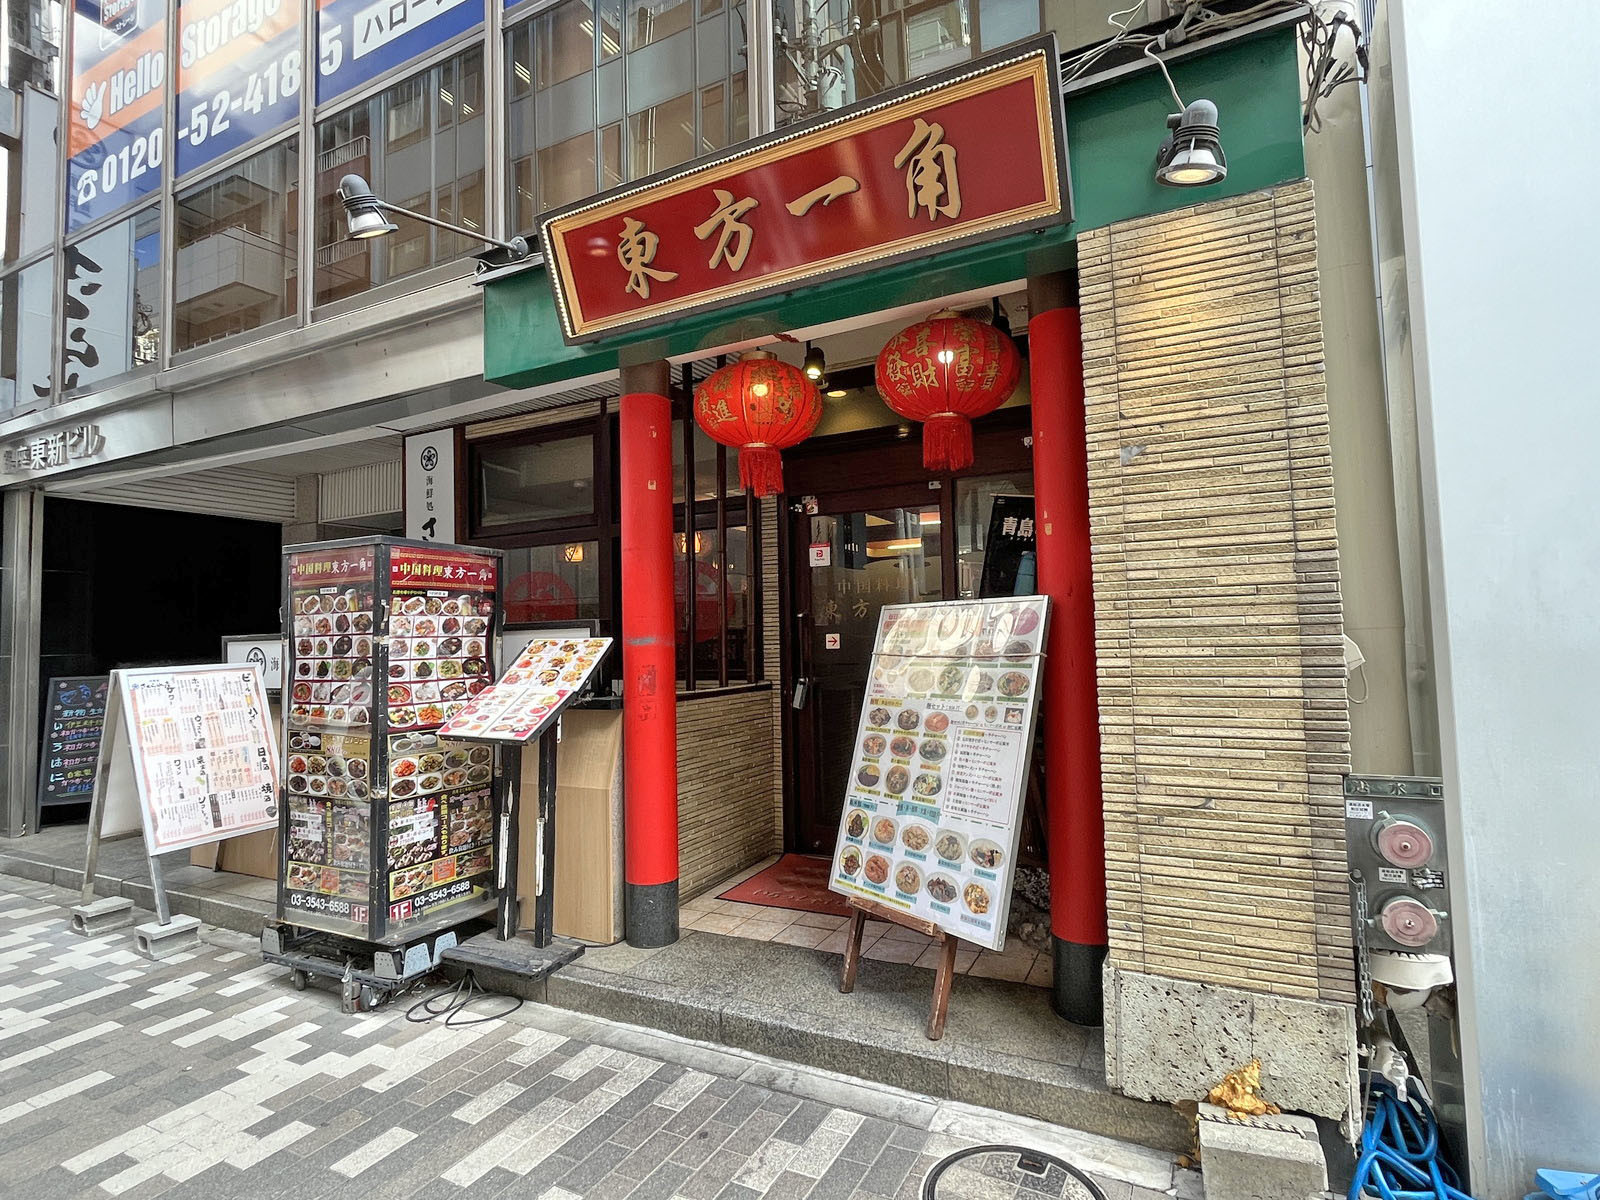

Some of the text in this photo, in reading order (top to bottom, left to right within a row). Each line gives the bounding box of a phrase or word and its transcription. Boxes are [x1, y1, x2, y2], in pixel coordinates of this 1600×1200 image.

[362, 0, 452, 44] ハロー
[110, 51, 164, 115] Hello
[615, 117, 962, 300] 東方一角
[400, 562, 488, 581] 中国料理東方一角
[291, 893, 350, 915] 03-3543-6588
[414, 881, 470, 907] 03-3543-6588
[353, 905, 367, 923] 1F
[392, 902, 409, 921] 1F
